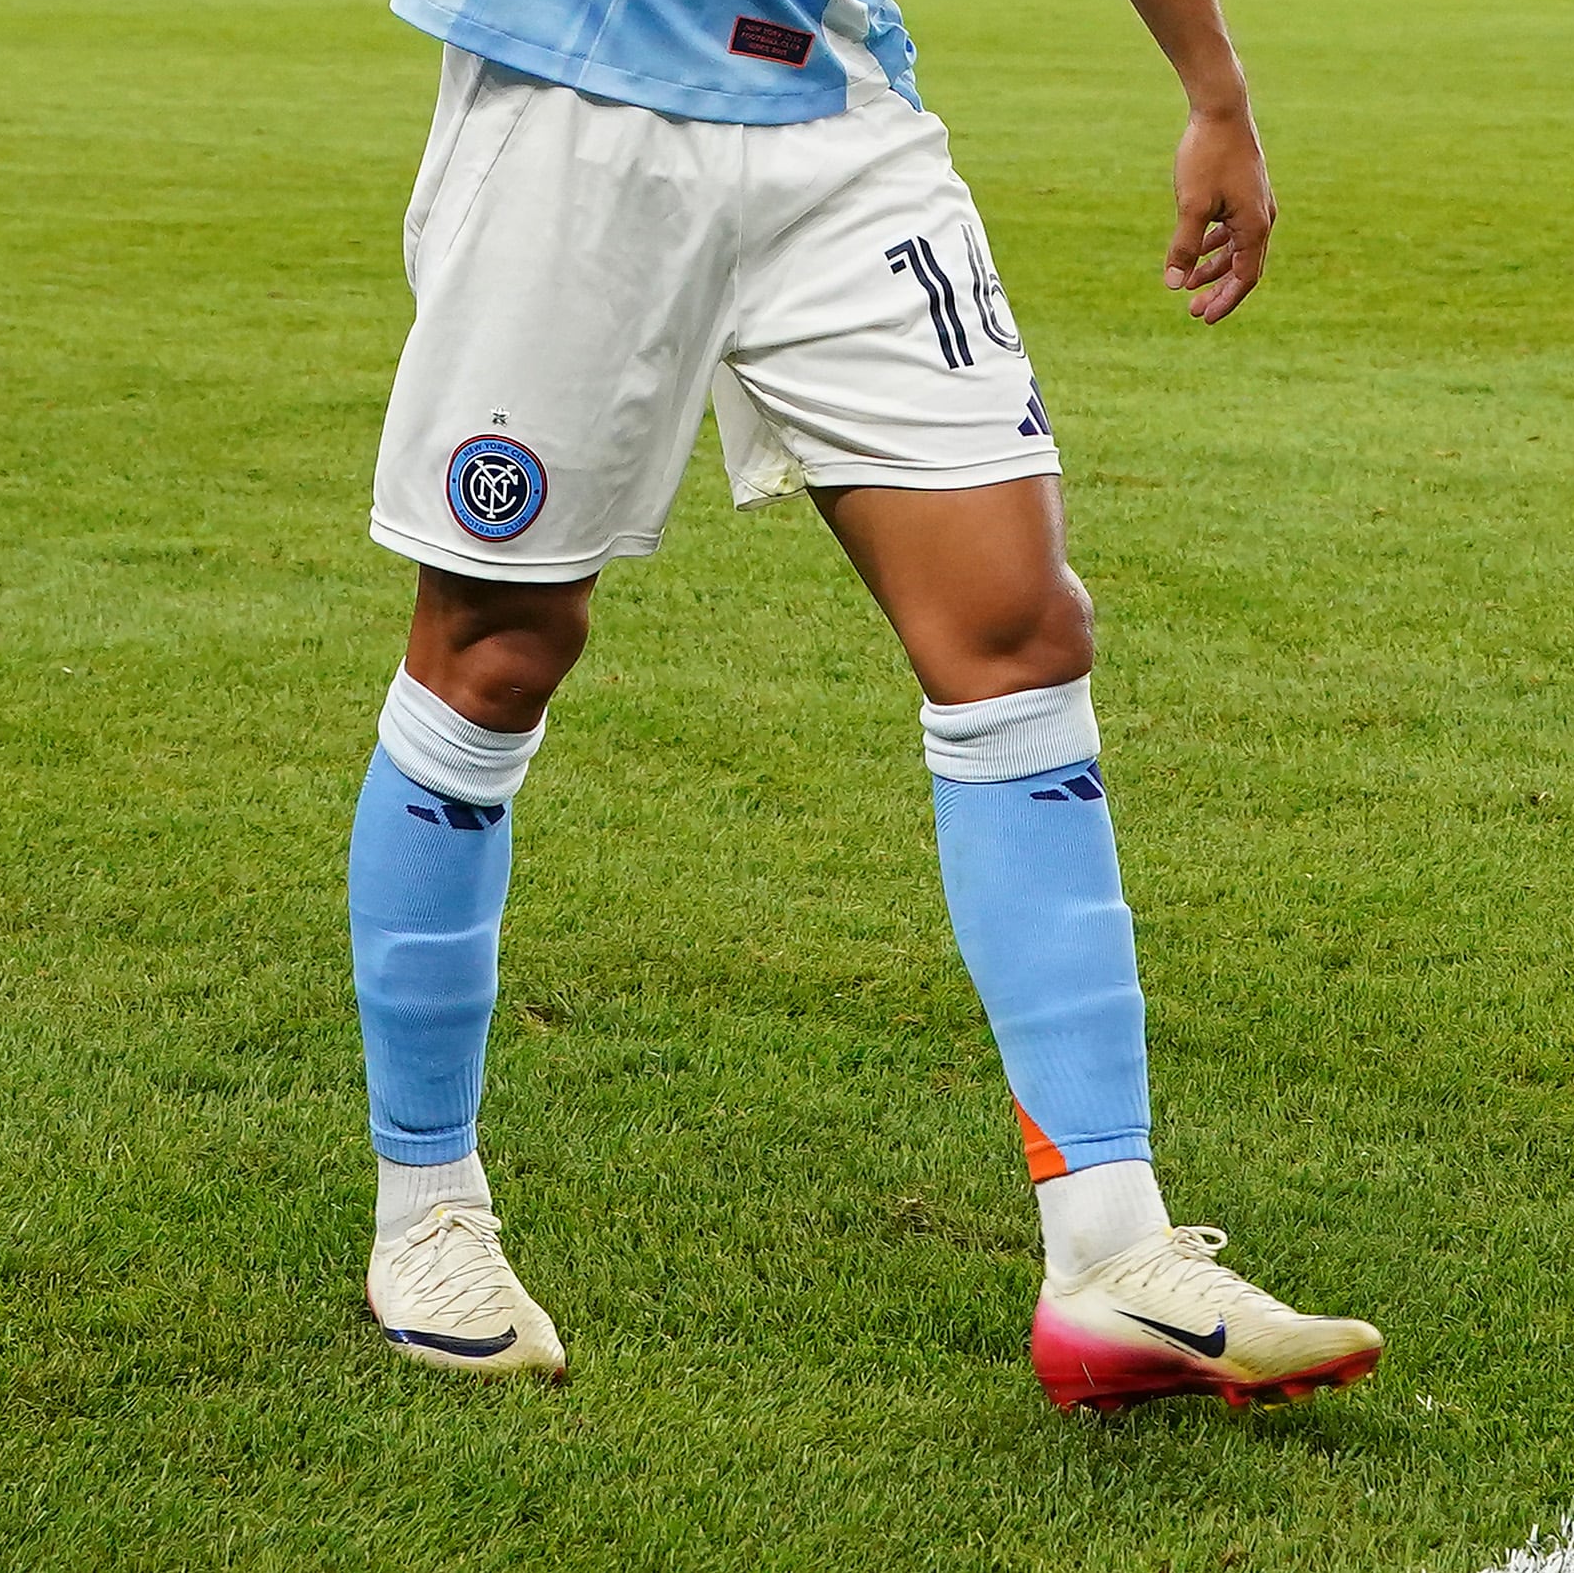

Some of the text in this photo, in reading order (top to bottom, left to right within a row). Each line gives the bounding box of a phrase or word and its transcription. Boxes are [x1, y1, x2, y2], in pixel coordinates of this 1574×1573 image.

[884, 224, 1026, 370] 16
[463, 441, 531, 466] NEW YORK CITY
[458, 508, 501, 535] FOOTBALL
